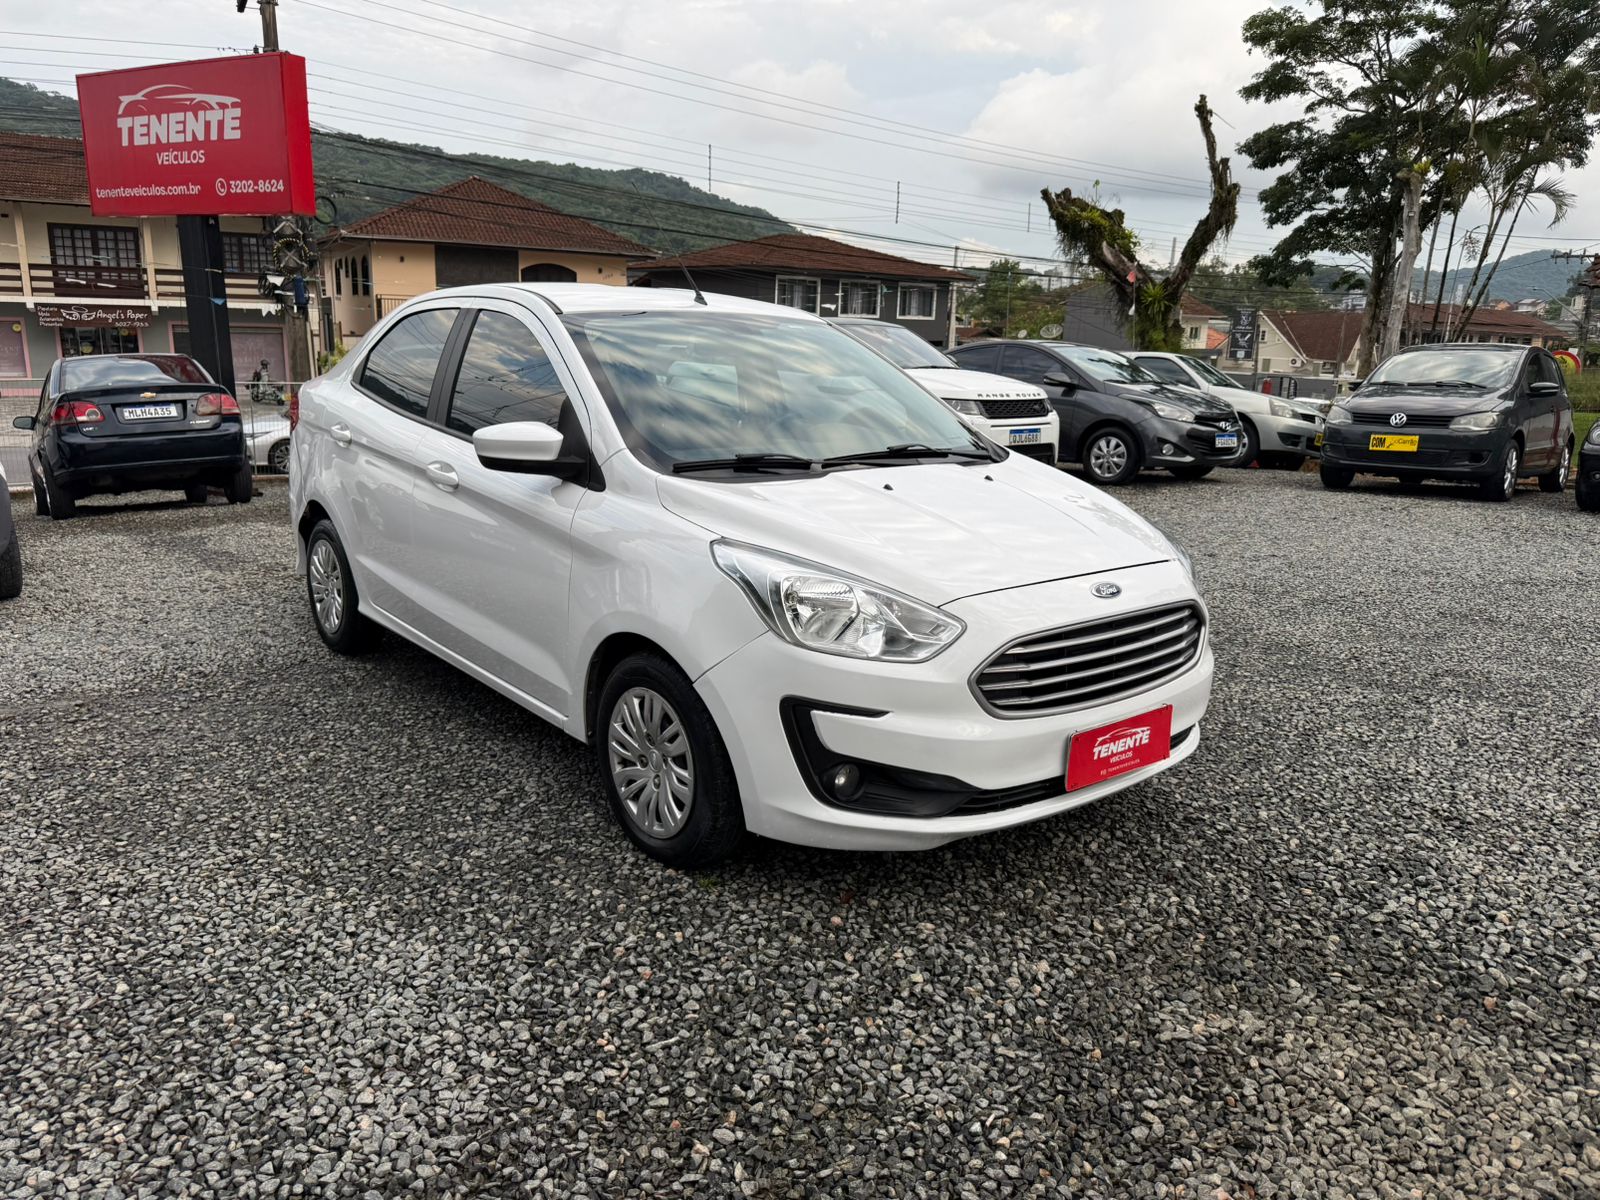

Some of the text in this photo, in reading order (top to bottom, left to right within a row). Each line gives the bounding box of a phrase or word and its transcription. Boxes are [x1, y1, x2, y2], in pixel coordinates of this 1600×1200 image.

[117, 108, 241, 147] TENENTE
[156, 149, 205, 165] VEÍCULOS
[96, 182, 202, 198] tenenteveiculos.com.br
[229, 179, 284, 194] 3202-8624
[96, 309, 125, 323] Angel's
[128, 407, 172, 418] MLH4A35
[1093, 730, 1151, 760] TENENTE
